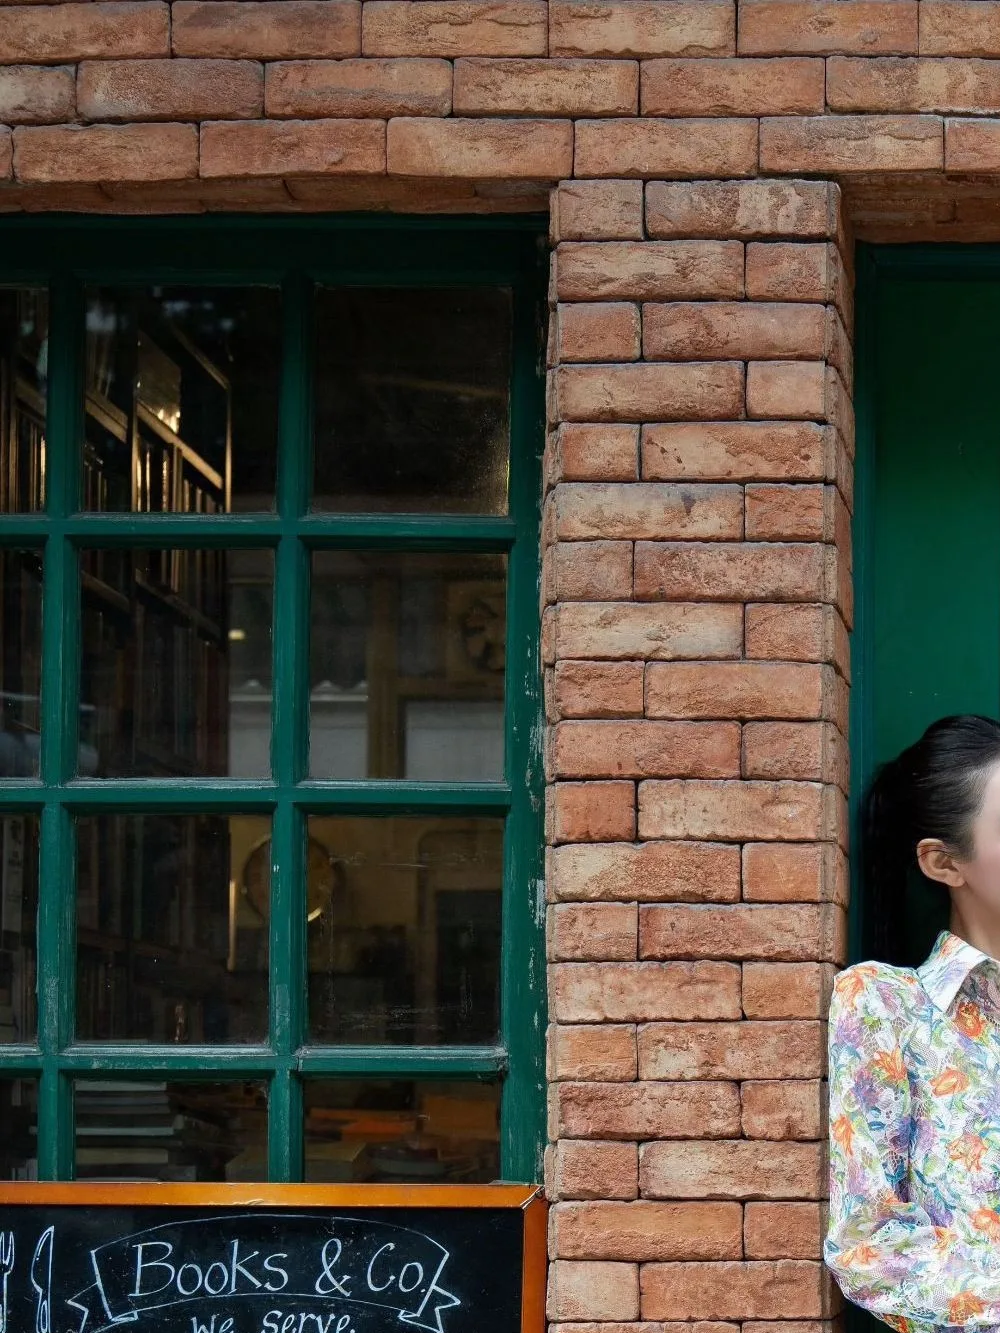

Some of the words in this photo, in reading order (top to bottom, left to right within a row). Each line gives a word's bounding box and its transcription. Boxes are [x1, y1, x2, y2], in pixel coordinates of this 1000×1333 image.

[128, 1238, 289, 1297] Books
[314, 1238, 352, 1296] &
[366, 1242, 426, 1293] Co.
